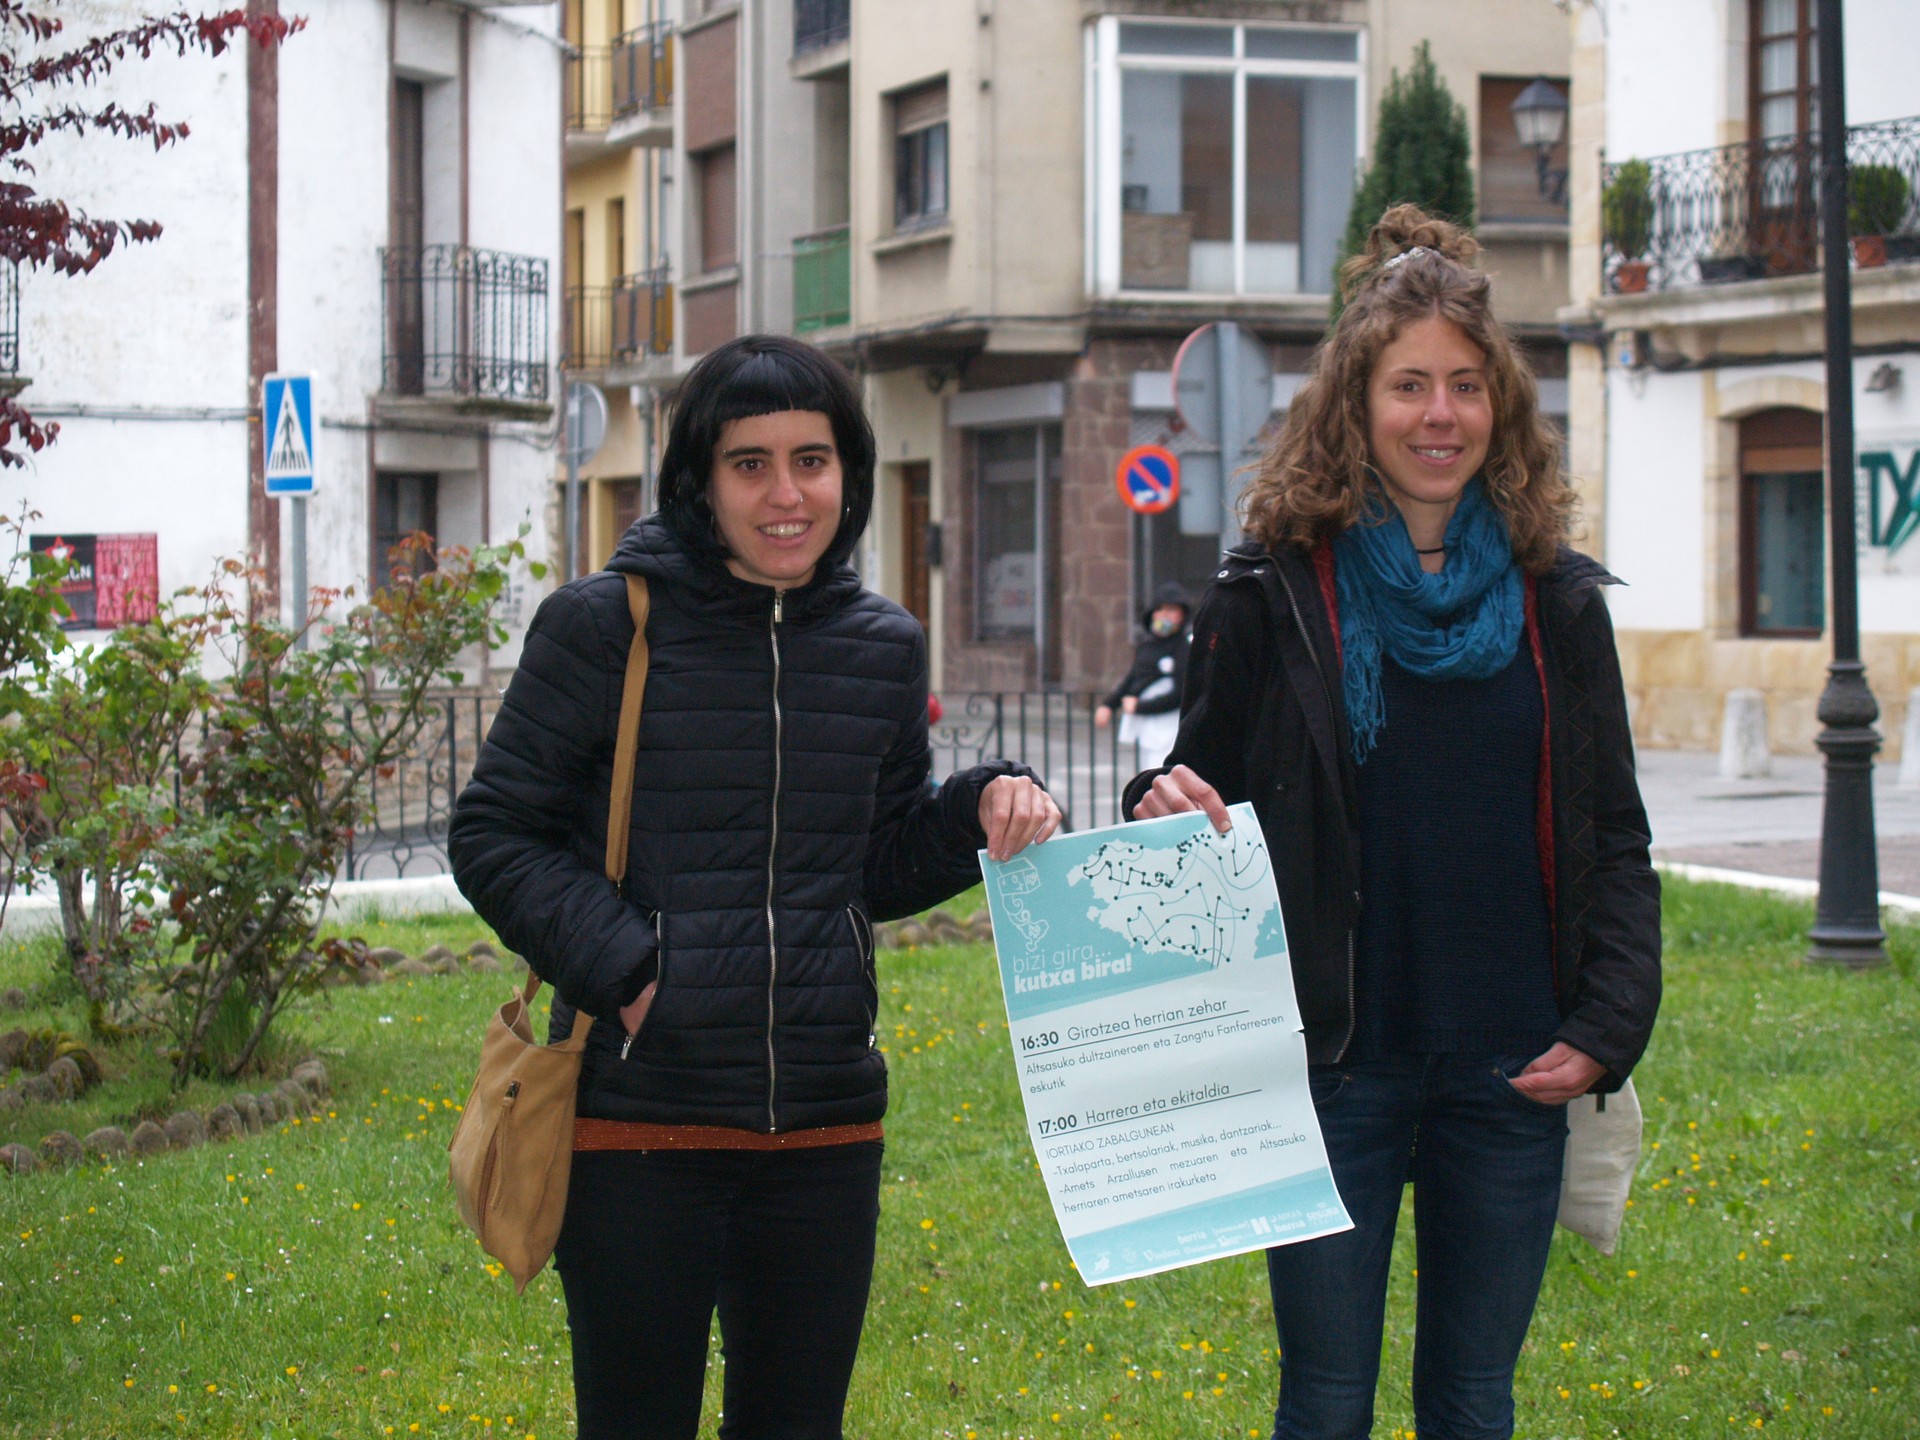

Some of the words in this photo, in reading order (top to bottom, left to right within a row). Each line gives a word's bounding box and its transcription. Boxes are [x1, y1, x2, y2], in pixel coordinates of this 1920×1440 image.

[1013, 949, 1045, 974] bizi
[1053, 944, 1111, 970] gira...
[1014, 968, 1075, 994] kutxa
[1081, 952, 1132, 981] bira!
[1020, 1031, 1059, 1051] 16:30
[1067, 1022, 1130, 1041] Girotzea
[1133, 1009, 1184, 1028] herrian
[1188, 999, 1227, 1017] zehar
[1026, 1057, 1076, 1075] Altsasuko
[1078, 1043, 1150, 1064] dultzaineroen
[1153, 1038, 1171, 1048] eta
[1173, 1030, 1214, 1045] Zangitu
[1216, 1015, 1284, 1035] Fanfarrearen
[1030, 1077, 1066, 1094] eskutik
[1038, 1114, 1077, 1134] 17:00
[1085, 1104, 1139, 1125] Harrera
[1143, 1098, 1166, 1112] eta
[1170, 1082, 1230, 1105] ekitaldia
[1045, 1140, 1095, 1159] IORTIAKO
[1097, 1122, 1175, 1148] ZABALGUNEAN
[1053, 1157, 1115, 1176] -Txalaparta,
[1116, 1141, 1179, 1163] bertsolariak,
[1181, 1134, 1218, 1149] musika,
[1220, 1120, 1282, 1141] dantzariak...
[1059, 1180, 1096, 1194] -Amets
[1107, 1167, 1158, 1184] Arzallusen
[1170, 1153, 1219, 1171] mezuaren
[1230, 1146, 1248, 1157] eta
[1259, 1132, 1306, 1151] Altsasuko
[1063, 1197, 1110, 1213] herriaren
[1112, 1184, 1166, 1203] ametsaren
[1168, 1172, 1217, 1190] irakurketa
